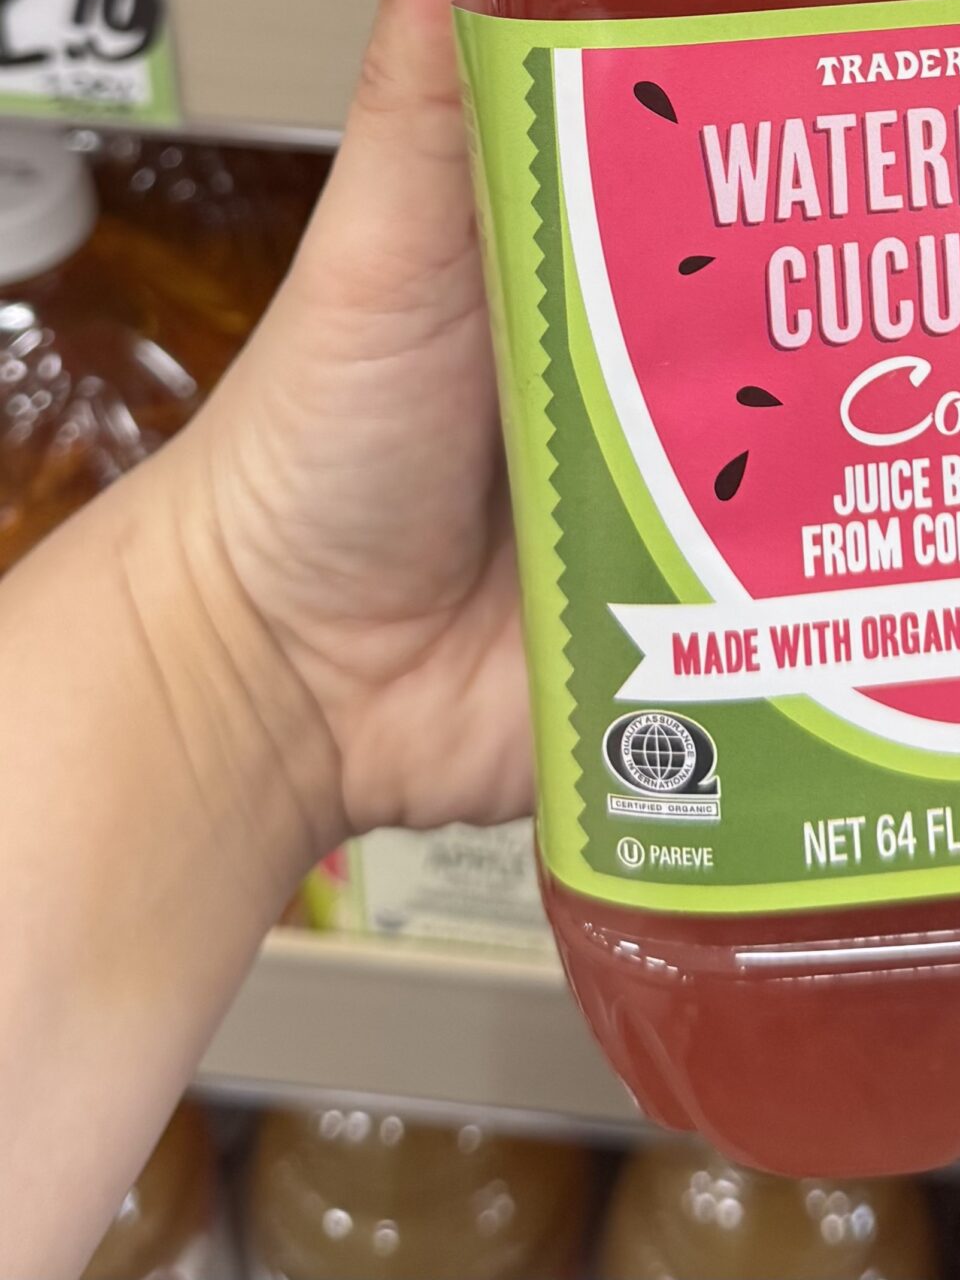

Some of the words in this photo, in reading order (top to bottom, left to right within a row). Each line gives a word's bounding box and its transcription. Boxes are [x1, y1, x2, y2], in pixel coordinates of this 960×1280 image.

[833, 458, 930, 516] JUICE
[802, 519, 902, 578] FROM
[672, 628, 760, 675] MADE
[770, 619, 852, 668] WITH
[623, 720, 643, 756] QUALITY
[645, 714, 695, 758] ASSURANCE
[626, 759, 694, 790] INTERNATIONAL
[615, 799, 662, 812] CERTIFIED
[668, 804, 713, 814] ORGANIC
[650, 844, 713, 867] PAREVE
[803, 817, 866, 866] NET
[876, 811, 916, 858] 64
